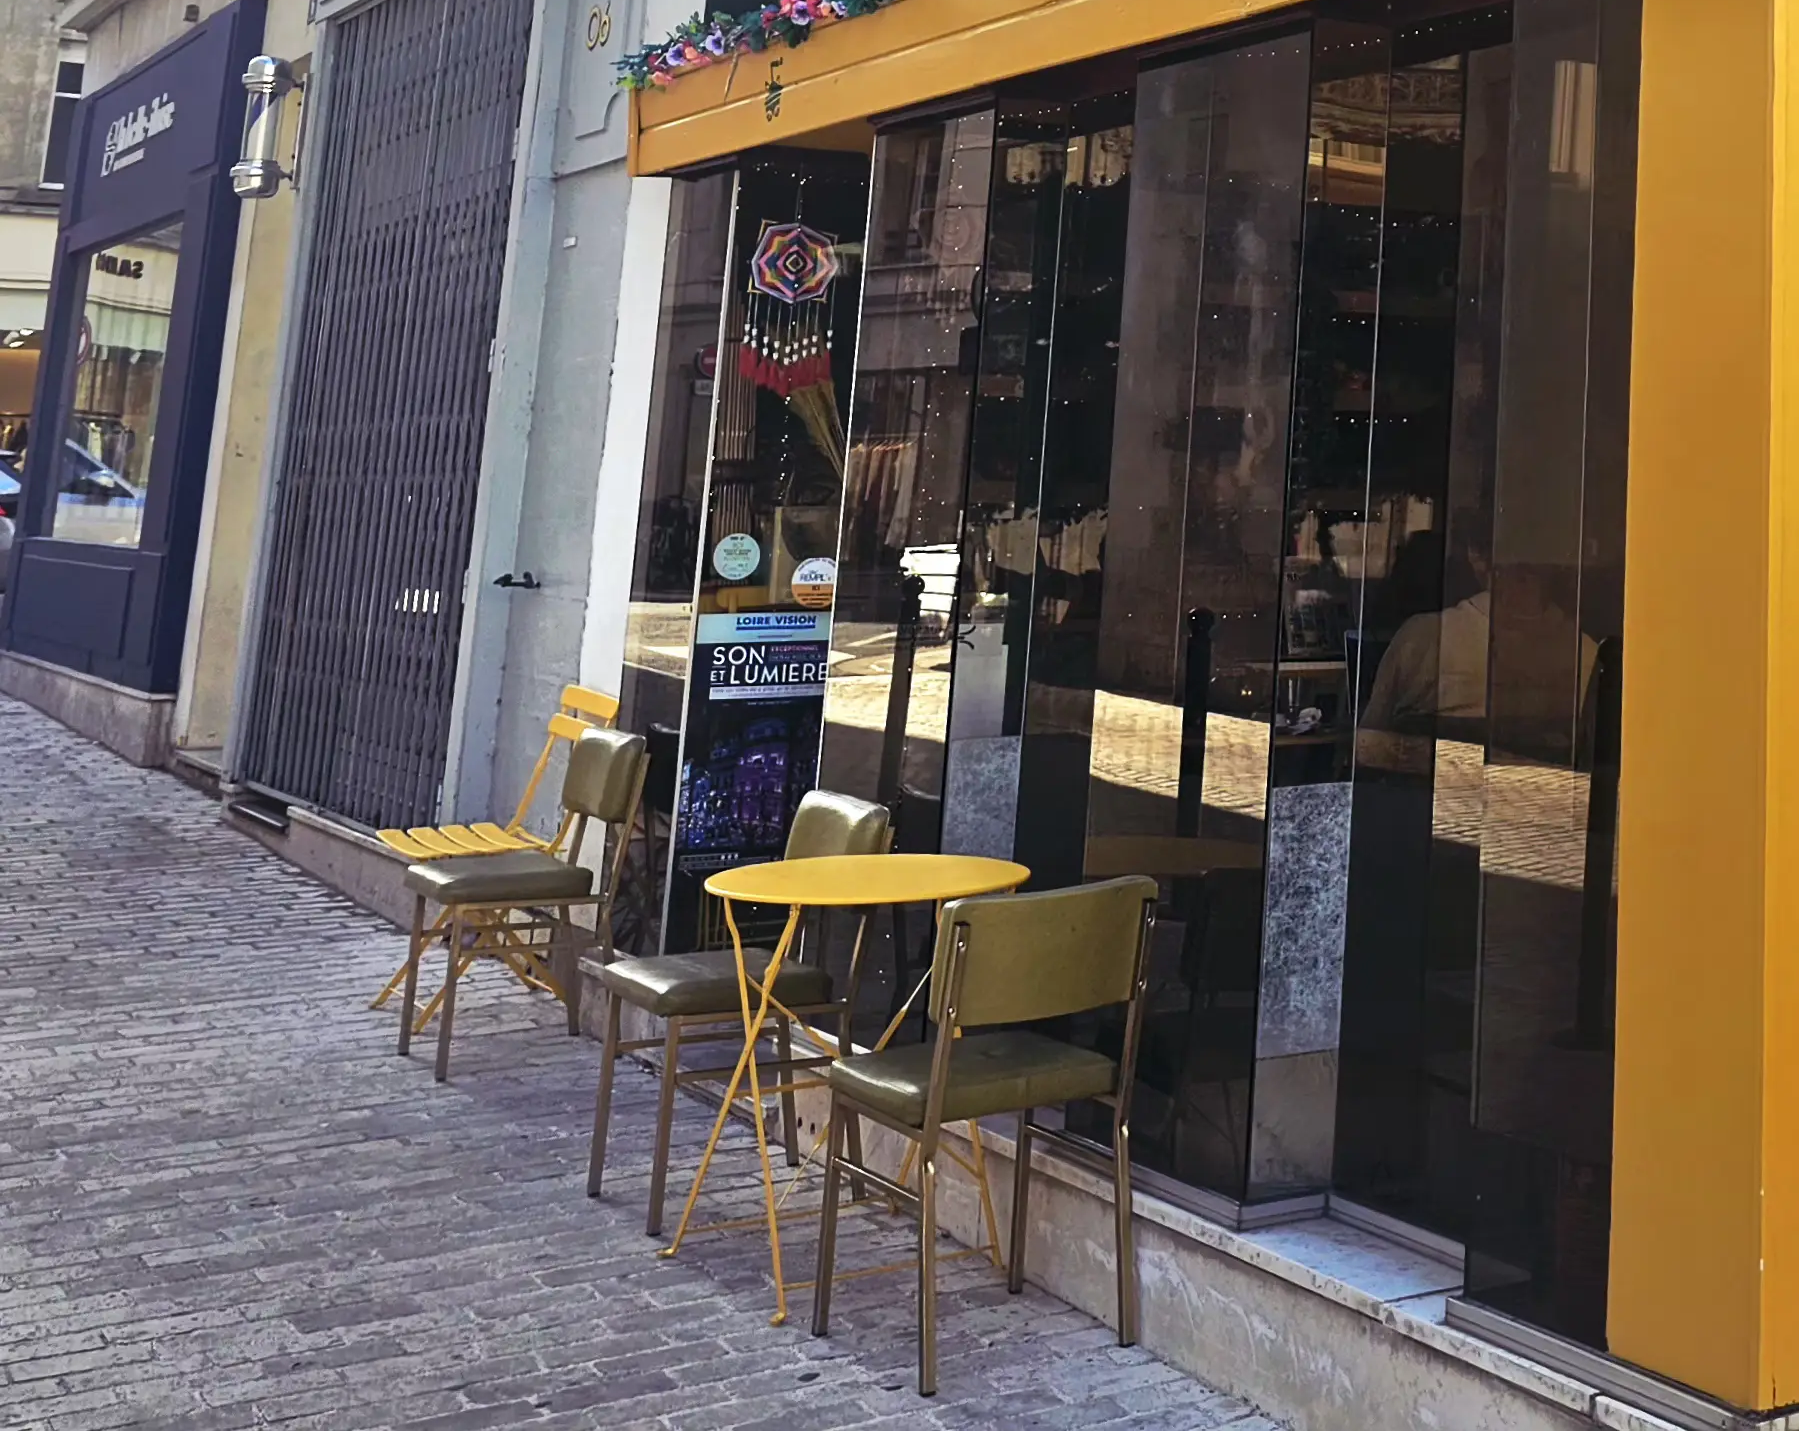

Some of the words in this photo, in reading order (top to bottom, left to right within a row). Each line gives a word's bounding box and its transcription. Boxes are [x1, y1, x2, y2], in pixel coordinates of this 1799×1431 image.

[736, 616, 770, 626] LOIRE
[776, 615, 817, 625] VISION
[713, 645, 765, 666] SON
[710, 670, 726, 682] ET
[730, 663, 828, 685] LUMIERE
